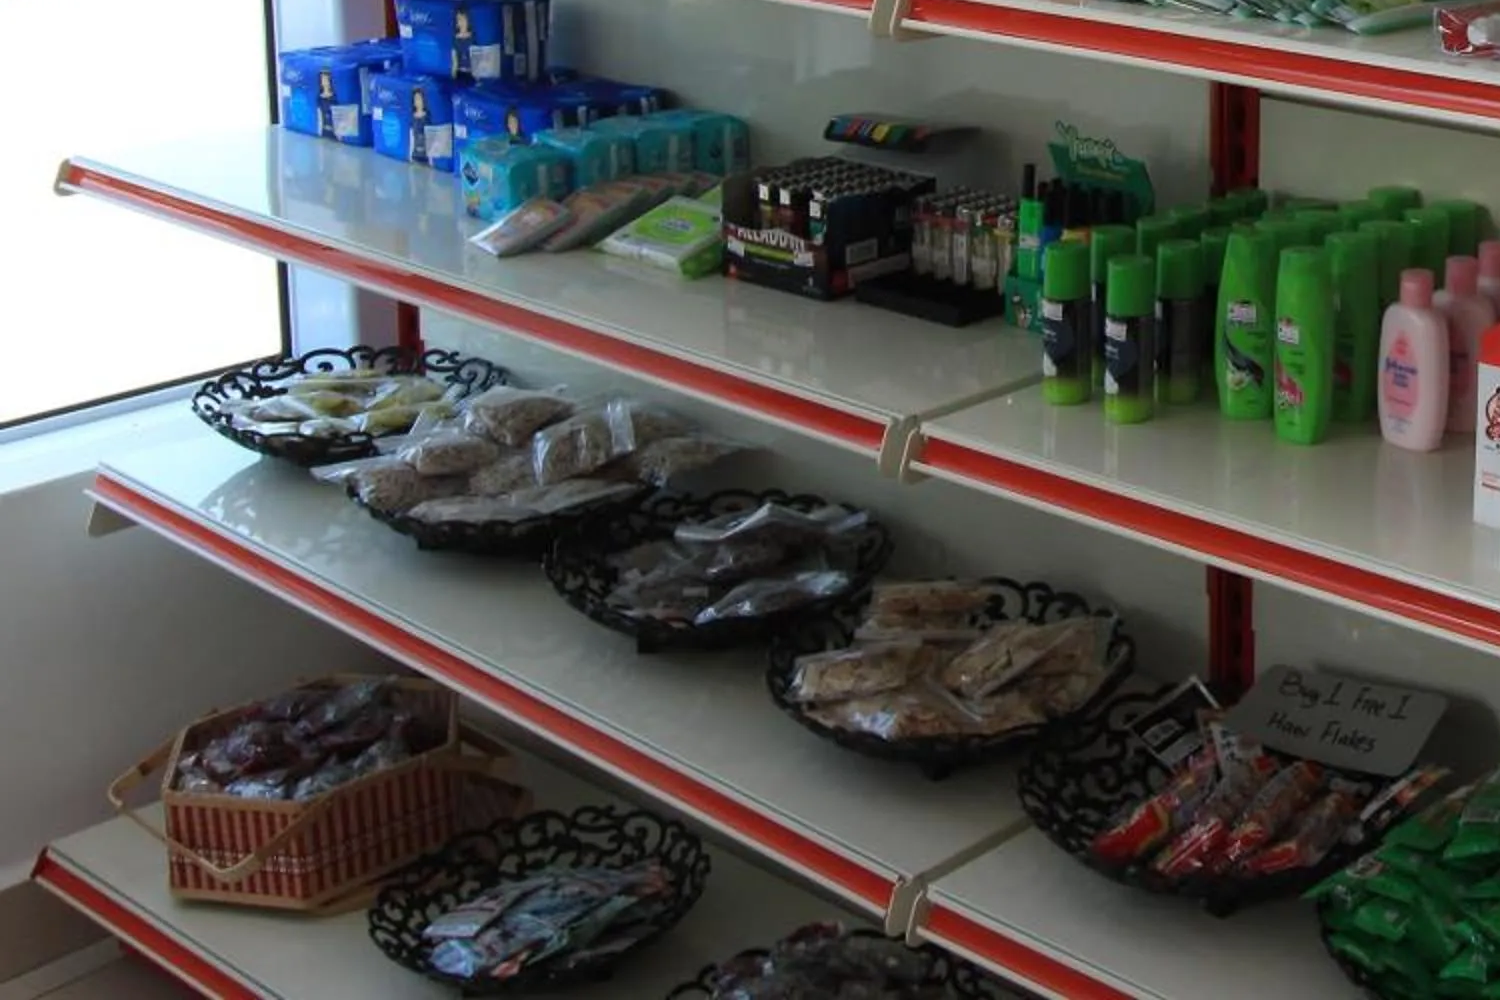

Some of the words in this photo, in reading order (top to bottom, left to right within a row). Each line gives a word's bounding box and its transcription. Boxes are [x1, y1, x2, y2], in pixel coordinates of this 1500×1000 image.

[1279, 669, 1320, 709] Buy
[1352, 686, 1388, 717] Free
[1320, 720, 1378, 754] Flakes
